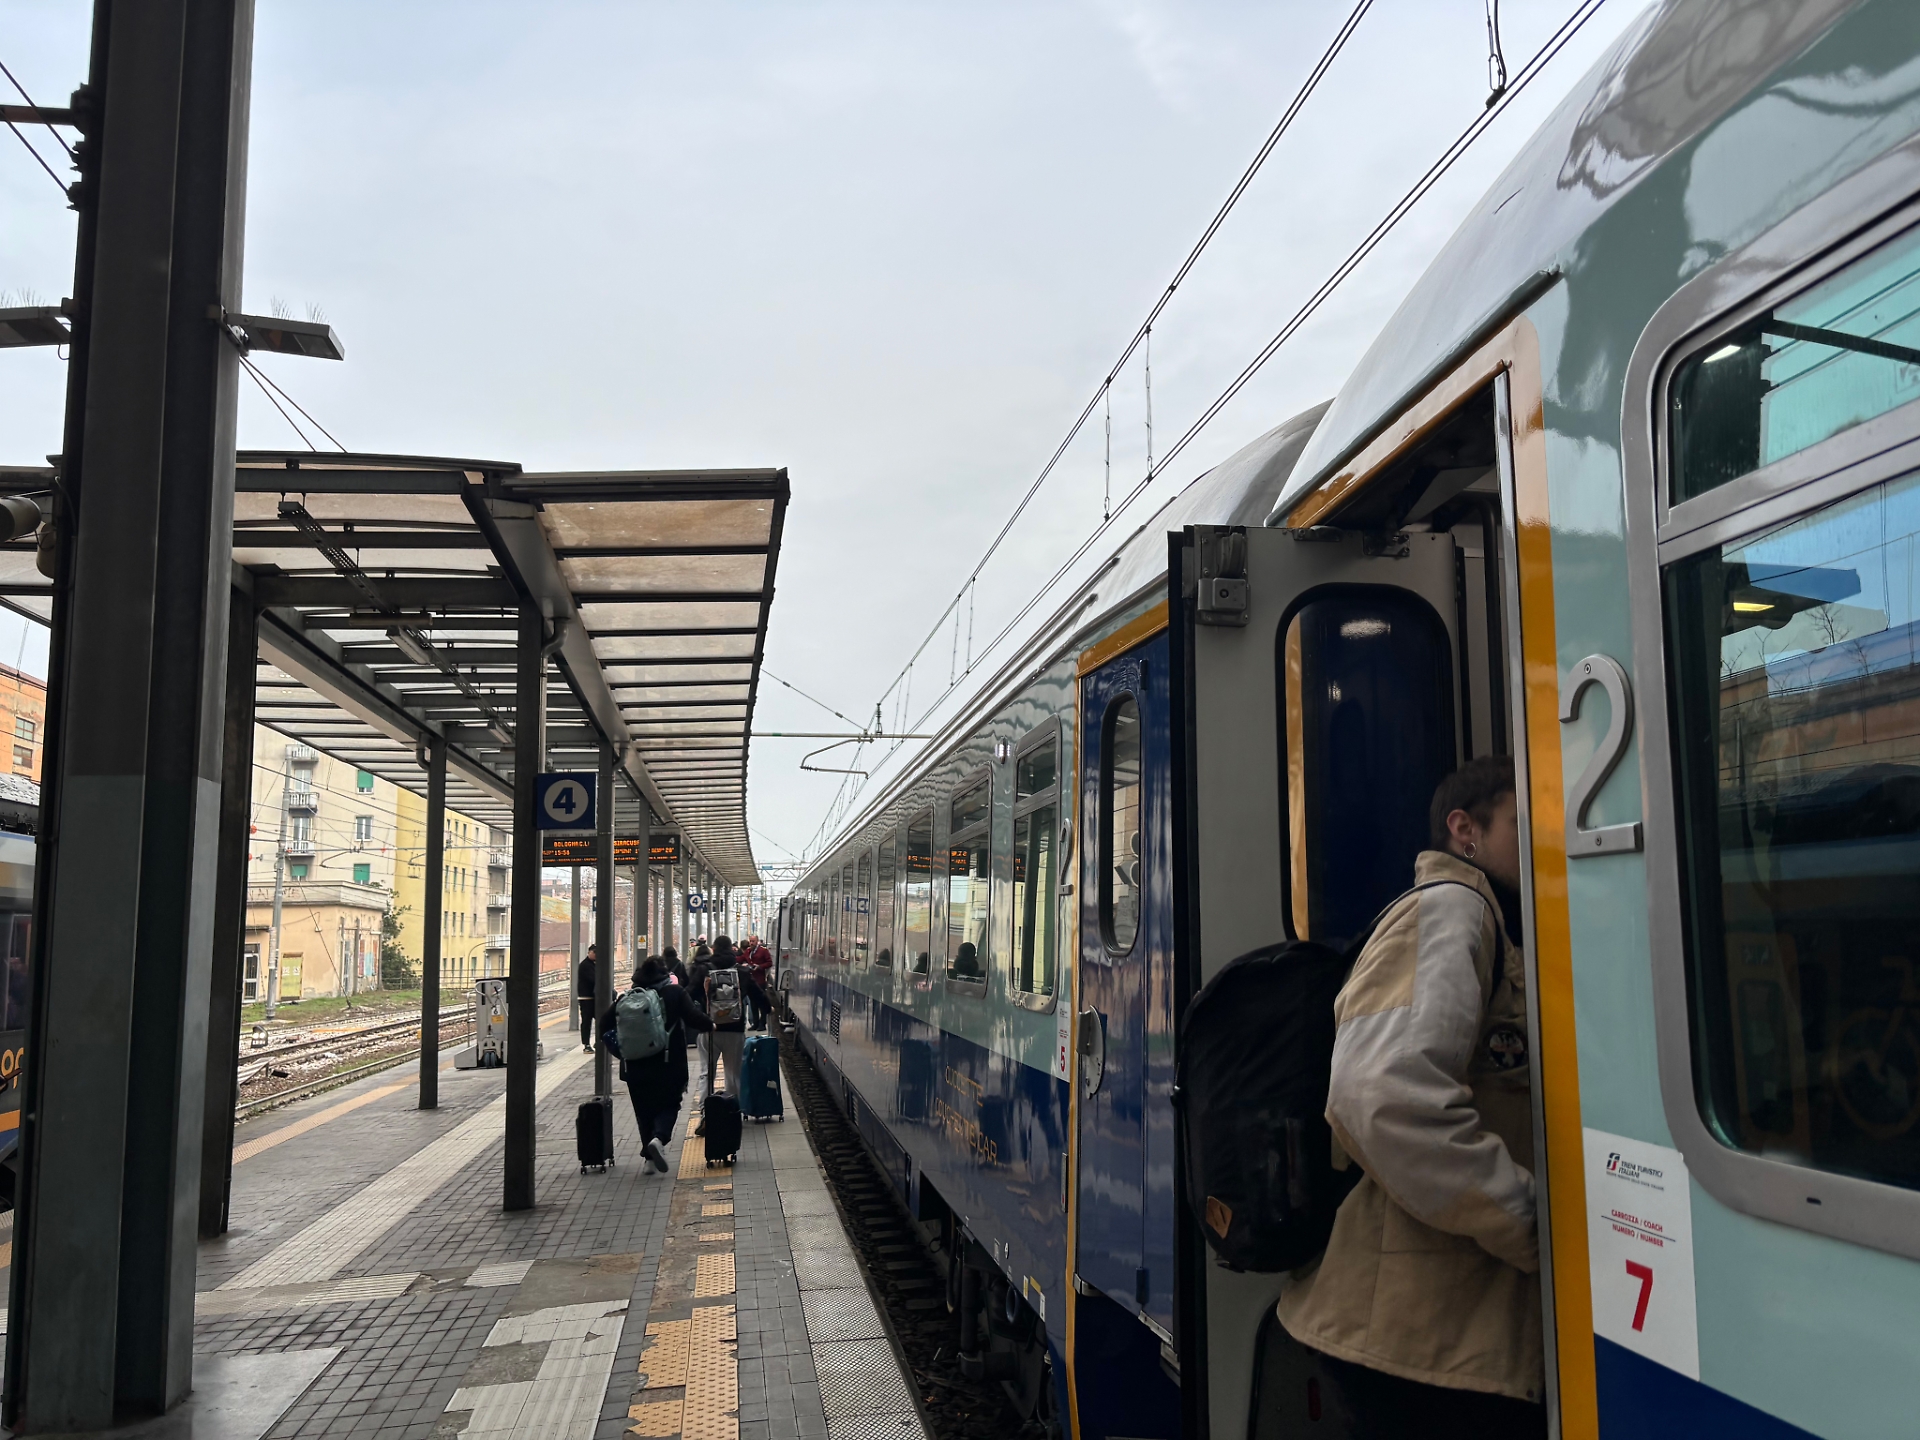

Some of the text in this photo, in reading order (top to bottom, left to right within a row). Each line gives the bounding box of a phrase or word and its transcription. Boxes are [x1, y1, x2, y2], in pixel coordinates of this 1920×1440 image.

[1558, 653, 1643, 858] 2
[552, 787, 576, 814] 4
[1059, 818, 1074, 895] 2
[692, 897, 699, 905] 4
[1060, 1046, 1066, 1072] 5
[977, 1131, 998, 1166] CAR
[1618, 1167, 1640, 1178] ITALIANI
[1621, 1161, 1663, 1178] TRENI TURISTICI
[1611, 1209, 1639, 1224] CARROZZA
[1643, 1220, 1663, 1232] COACH
[1612, 1223, 1635, 1238] NUMERO
[1640, 1233, 1664, 1247] NUMBER
[1625, 1259, 1653, 1332] 7
